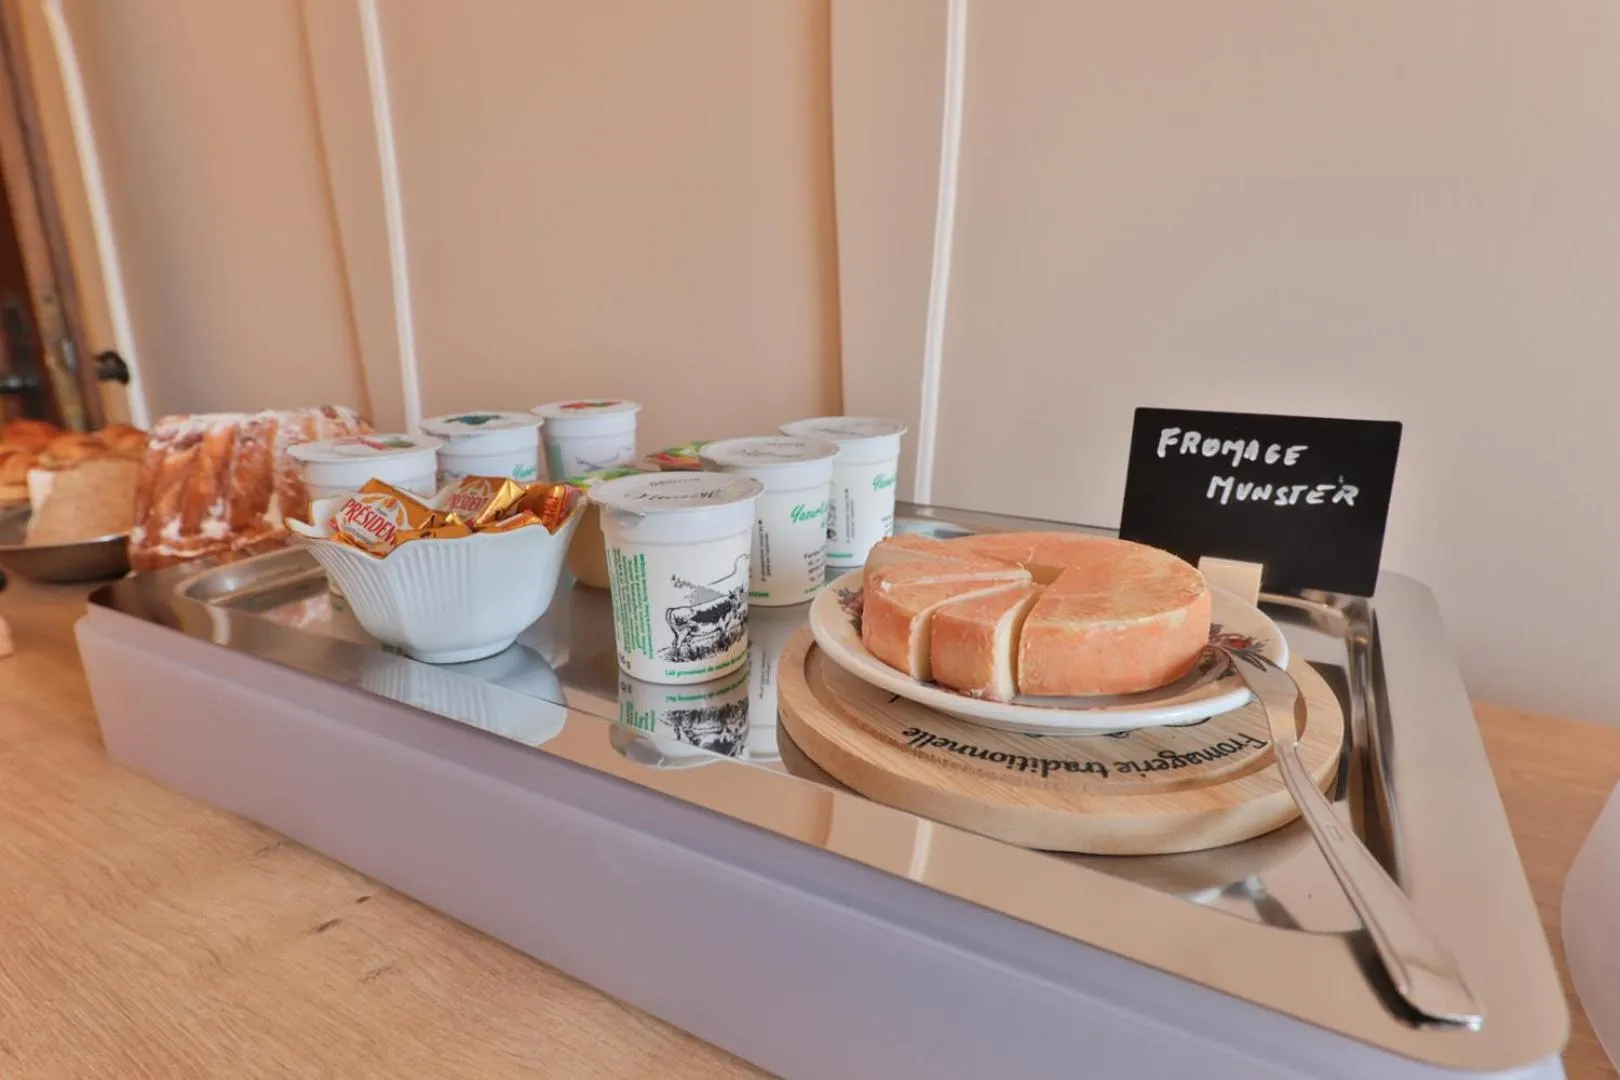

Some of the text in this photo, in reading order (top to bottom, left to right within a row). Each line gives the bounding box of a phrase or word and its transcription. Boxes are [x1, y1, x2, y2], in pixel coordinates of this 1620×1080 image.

[1156, 426, 1310, 468] FROMAGE
[1206, 475, 1361, 507] MUNSTER
[902, 727, 1269, 779] Fromagerie traditionnelle
